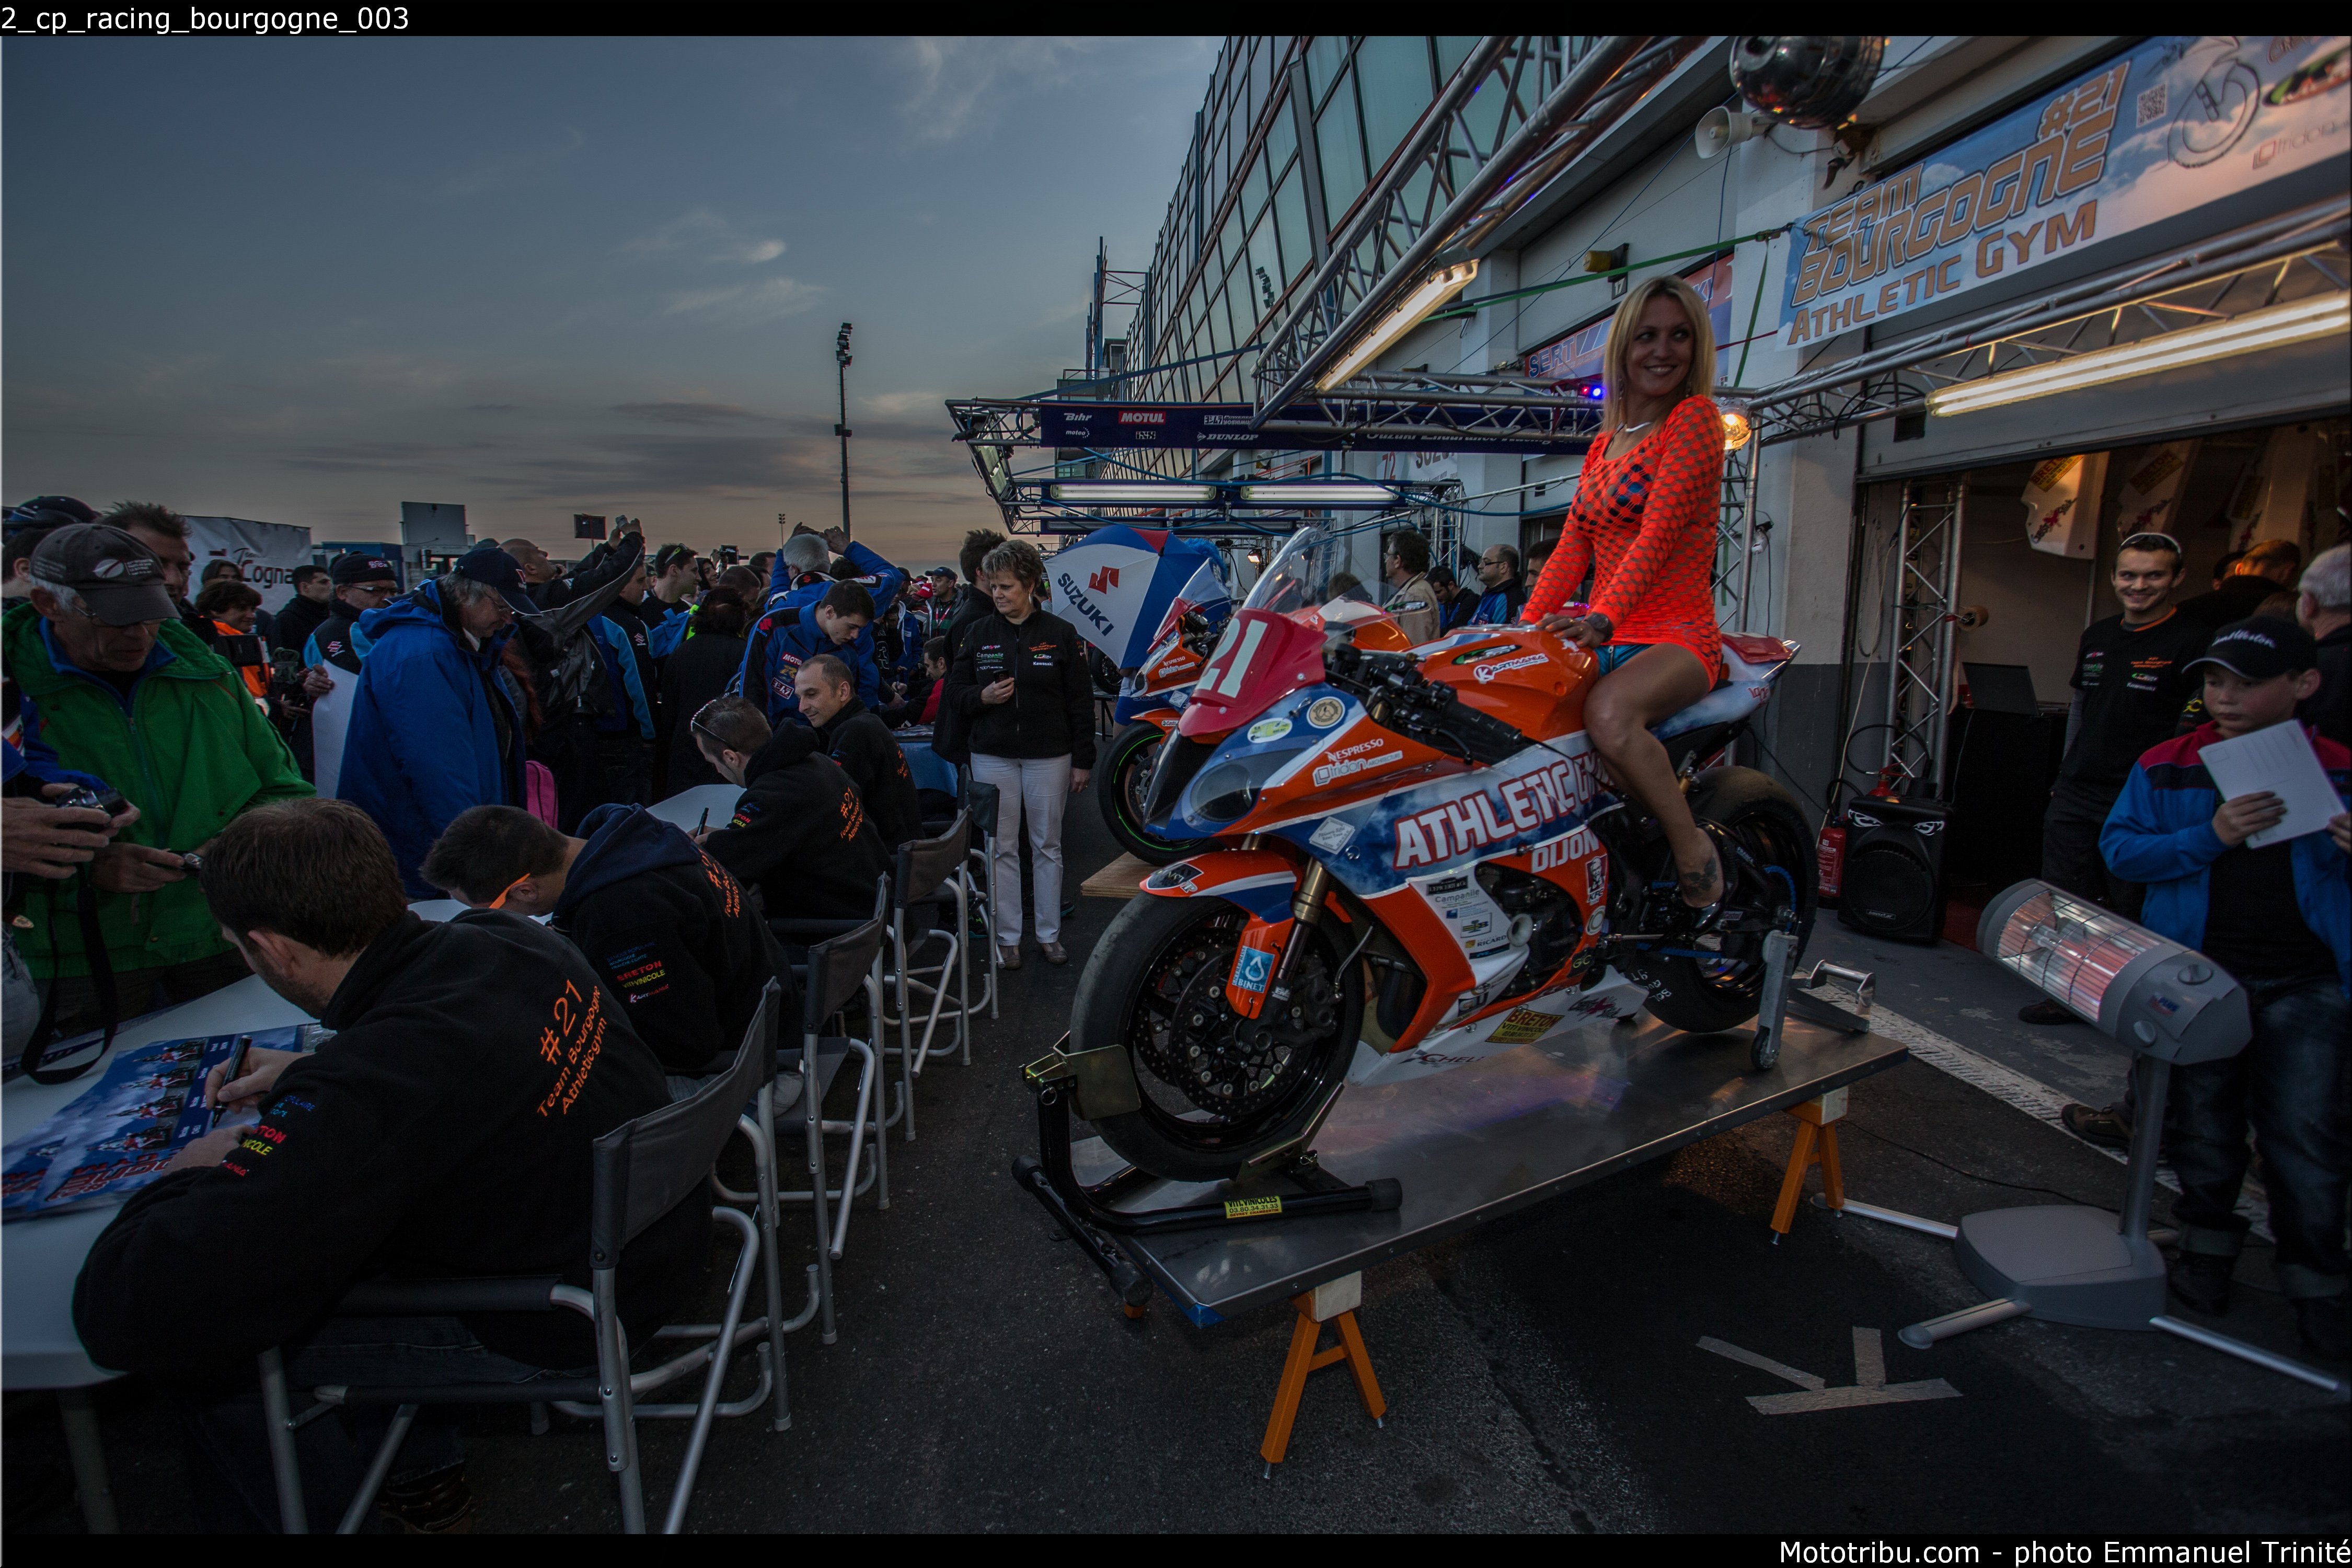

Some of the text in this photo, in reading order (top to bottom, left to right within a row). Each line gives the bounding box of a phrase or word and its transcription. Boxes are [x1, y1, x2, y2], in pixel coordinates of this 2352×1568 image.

[2037, 60, 2131, 141] #21
[1791, 107, 2118, 307] BOURGOGNE
[1804, 162, 1926, 254] TEAM
[1788, 200, 2097, 345] ATHLETIC GYM
[1529, 336, 1576, 378] SERT
[1064, 412, 1165, 423] Bihr MOTUL
[1057, 572, 1114, 637] SUZUKI
[782, 653, 803, 665] MOTU
[1162, 656, 1186, 667] NESPRESSO
[1194, 618, 1269, 699] 21
[1476, 654, 1547, 682] KARTMANIA
[1324, 737, 1385, 762] NESPRESSO
[1329, 758, 1366, 778] tridon
[1393, 759, 1576, 870] ATHLETIC
[1531, 828, 1600, 874] DIJON
[1435, 889, 1480, 903] Campanile
[1477, 935, 1507, 947] RICARD
[616, 960, 663, 982] BRETON
[1237, 977, 1265, 992] BINET
[537, 985, 601, 1117] Team Bourgogne
[562, 1017, 607, 1115] Athleticgym
[1229, 1203, 1278, 1213] 03.80.34.31.33
